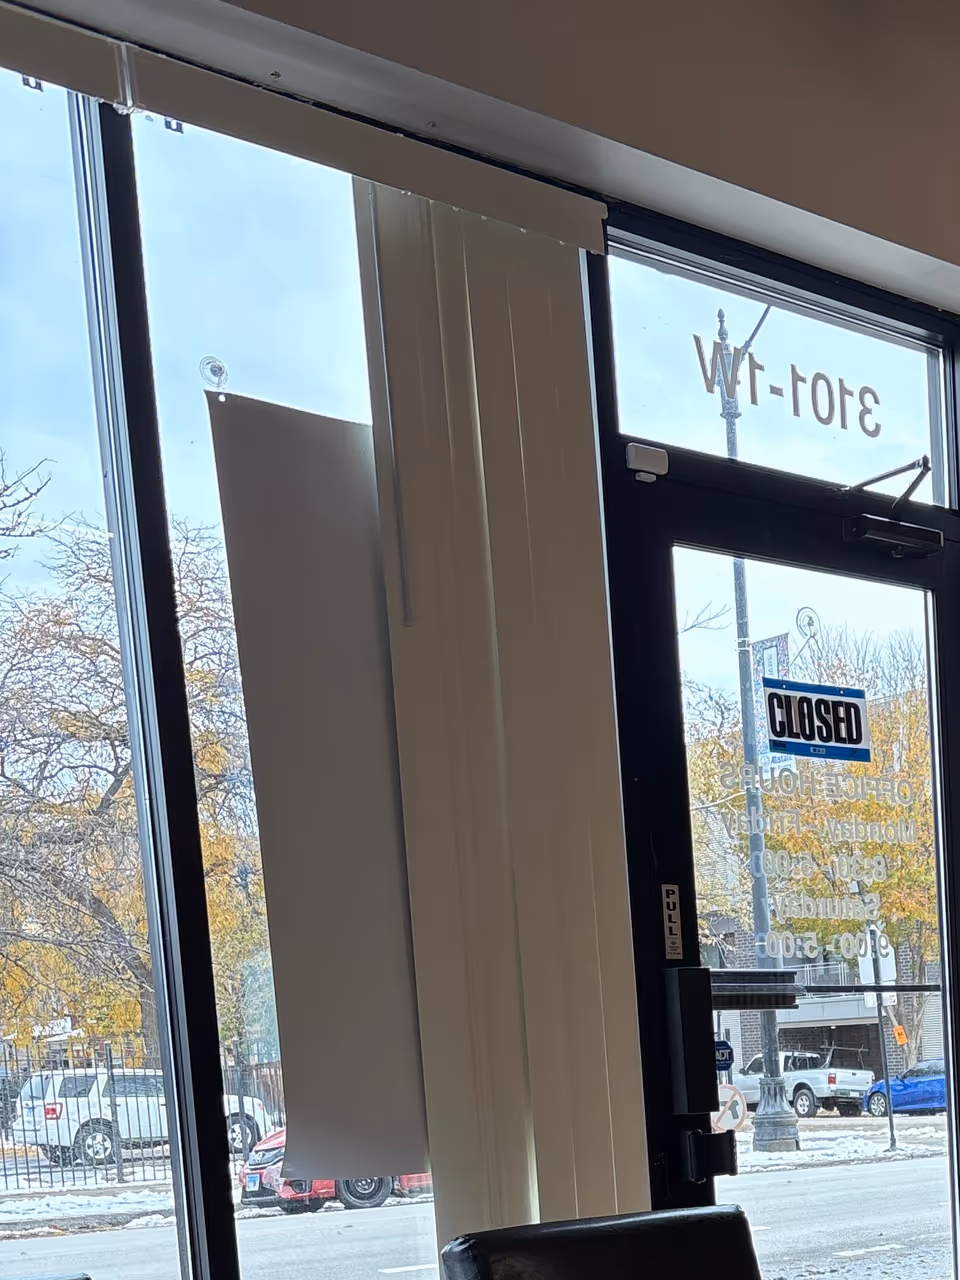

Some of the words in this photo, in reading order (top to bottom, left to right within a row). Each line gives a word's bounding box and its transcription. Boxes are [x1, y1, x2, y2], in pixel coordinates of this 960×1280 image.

[767, 691, 863, 746] CLOSED
[665, 888, 678, 936] PULL
[716, 1049, 731, 1060] ADT
